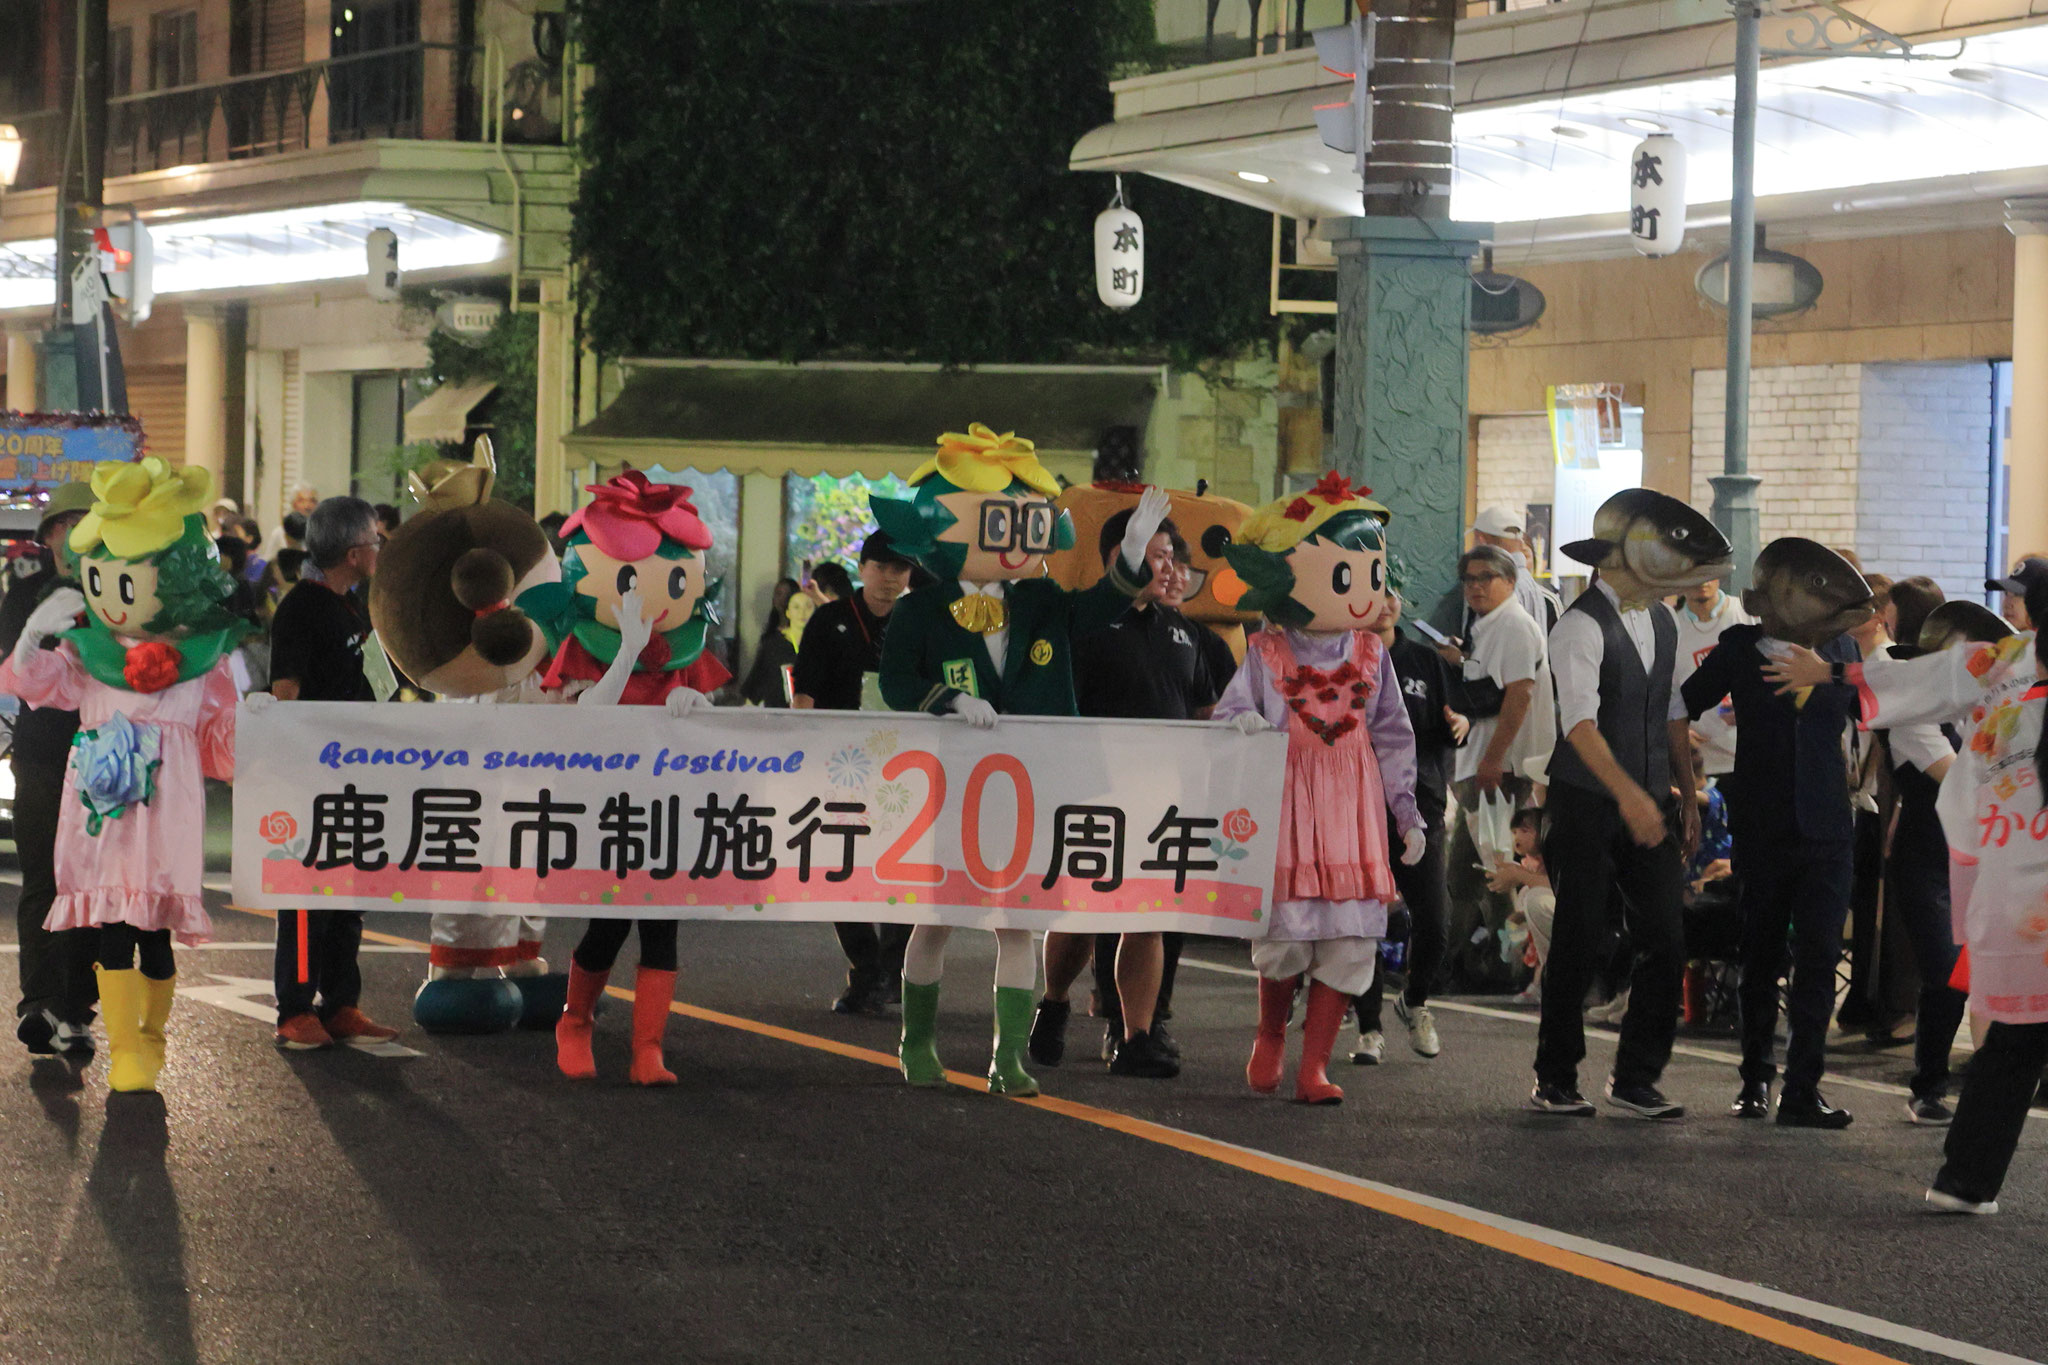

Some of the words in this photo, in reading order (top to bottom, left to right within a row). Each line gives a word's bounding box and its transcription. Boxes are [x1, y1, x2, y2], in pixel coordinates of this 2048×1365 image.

[1633, 151, 1663, 241] 本町
[1112, 222, 1138, 295] 本町
[319, 741, 469, 771] kanoya
[483, 751, 640, 772] summer
[652, 748, 804, 776] festival
[302, 749, 1219, 894] 鹿屋市制施行20周年
